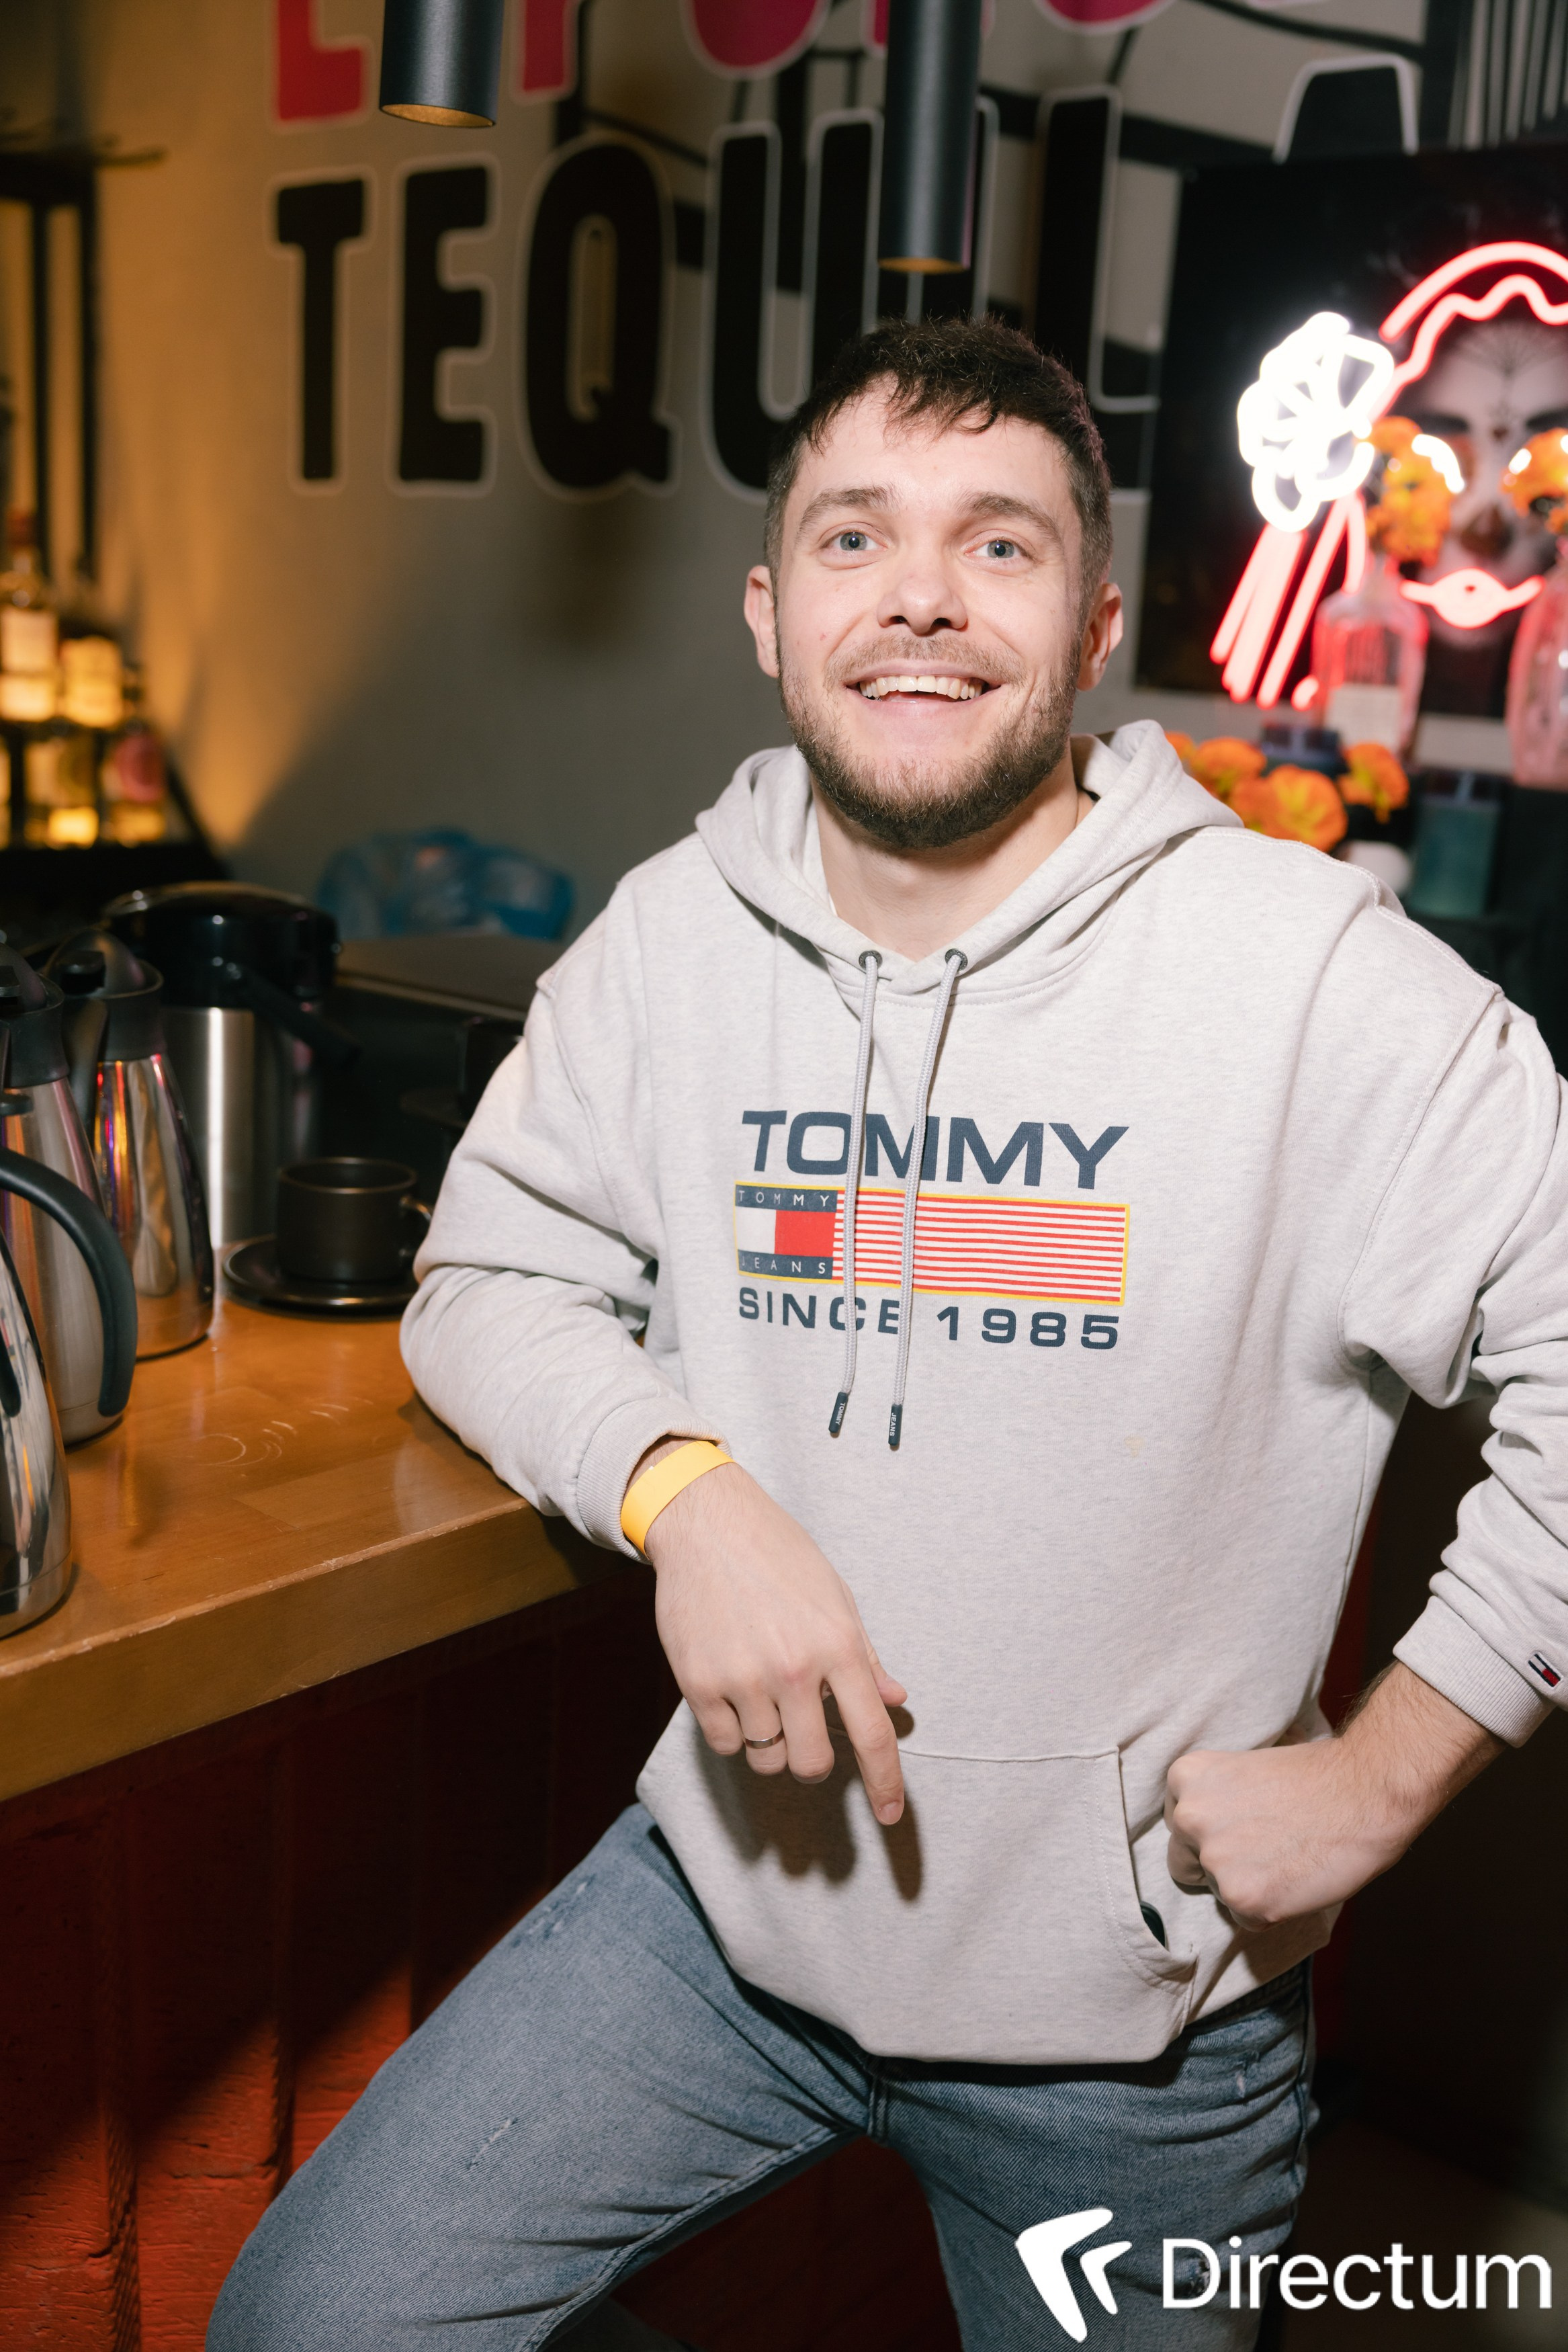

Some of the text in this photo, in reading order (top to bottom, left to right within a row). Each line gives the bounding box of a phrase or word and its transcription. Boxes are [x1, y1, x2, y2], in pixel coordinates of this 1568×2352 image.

[741, 1109, 1130, 1190] TOMMY
[738, 1189, 830, 1208] TOMMY
[741, 1257, 826, 1275] JEANS
[738, 1286, 1120, 1351] SINCE 1985
[835, 1402, 846, 1425] TOMMY
